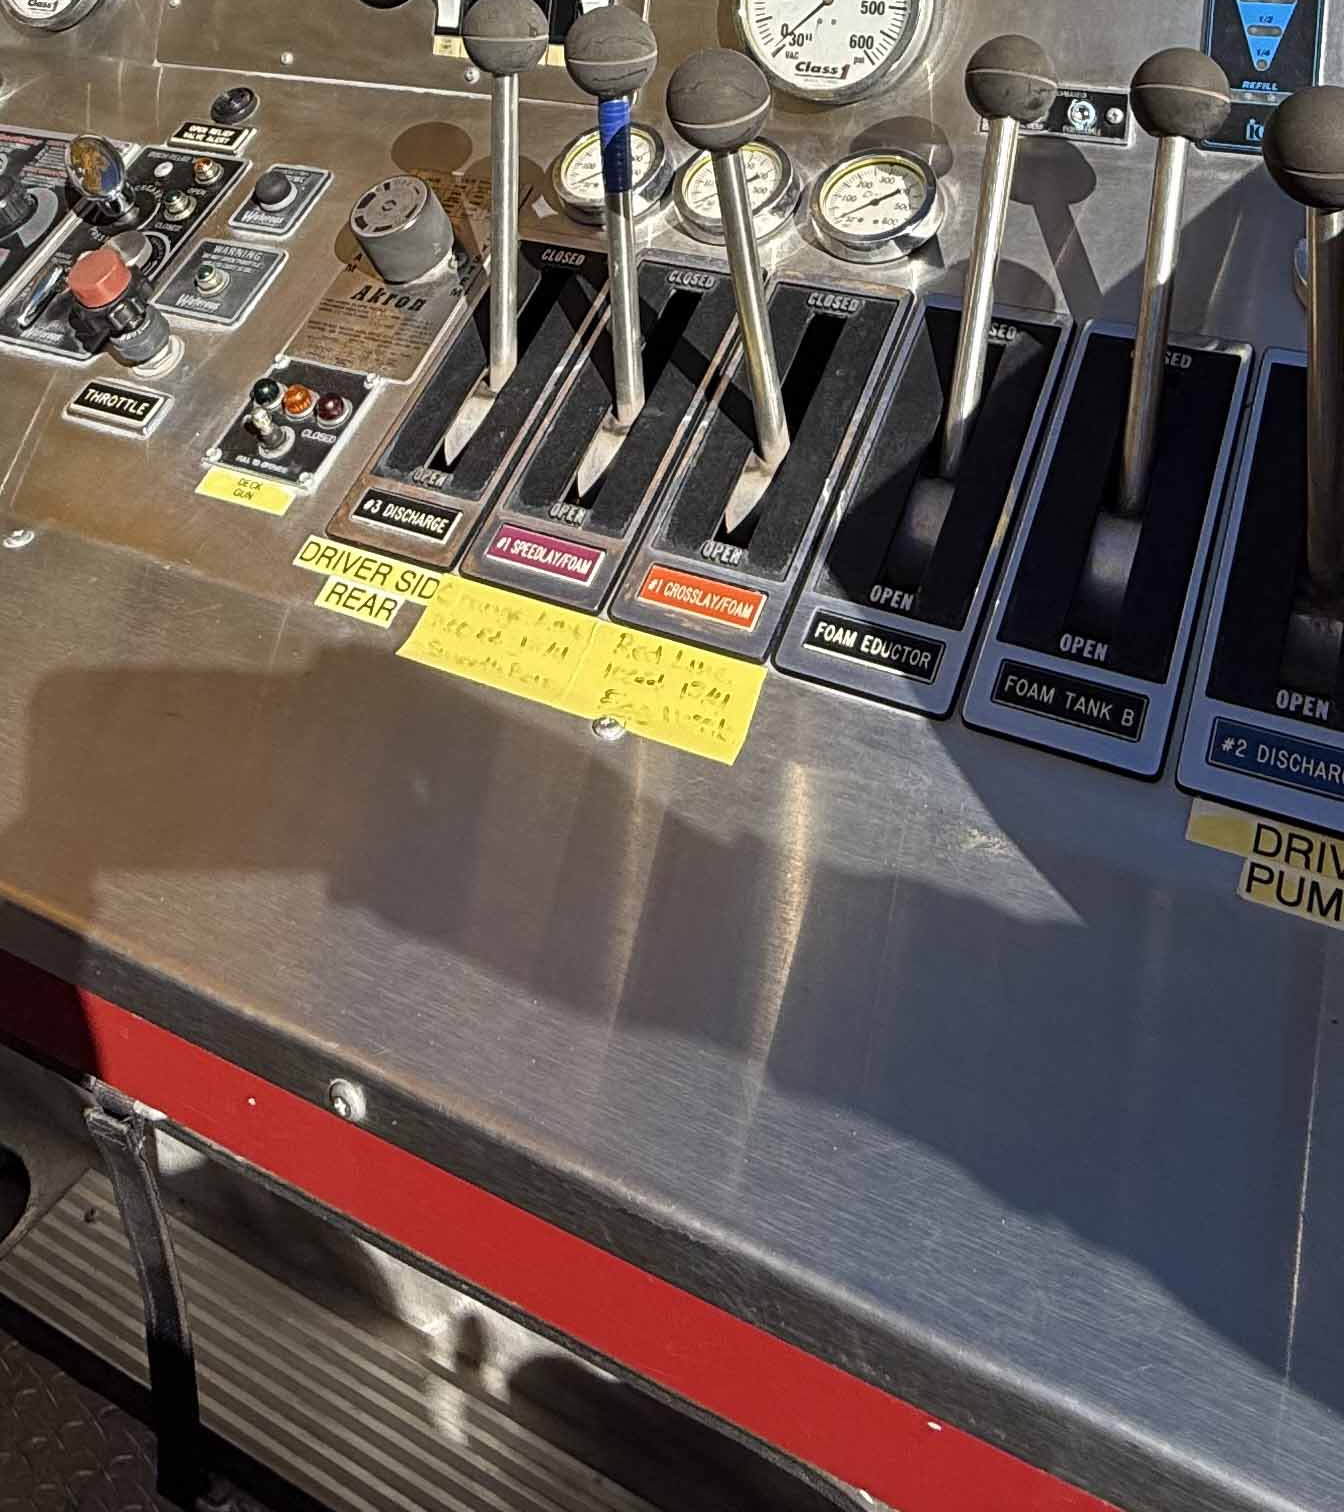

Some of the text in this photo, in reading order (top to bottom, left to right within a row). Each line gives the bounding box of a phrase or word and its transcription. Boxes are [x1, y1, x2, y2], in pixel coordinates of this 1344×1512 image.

[860, 1, 885, 15] 500
[849, 34, 874, 49] 600
[1242, 81, 1279, 90] REFILL
[541, 249, 586, 266] CLOSED
[668, 269, 715, 289] CLOSED
[351, 285, 427, 312] Akron
[807, 292, 859, 312] CLOSED
[84, 388, 150, 415] THROTTLE
[301, 429, 337, 443] CLOSED
[238, 478, 264, 490] DECK
[412, 467, 449, 487] OPEN
[233, 488, 254, 501] GUN
[363, 498, 450, 534] #3 DISCHARGE
[549, 503, 586, 525] OPEN
[496, 537, 592, 575] #1 SPEEDLAY/FOAM
[702, 540, 743, 564] OPEN
[299, 541, 440, 599] DRIVER SID
[324, 581, 398, 622] REAR
[648, 578, 754, 619] #1 CROSSLAY/FOAM
[869, 585, 914, 611] OPEN
[814, 621, 932, 670] FOAM EDUCTOR
[1059, 633, 1108, 662] OPEN
[1004, 674, 1135, 727] FOAM TANK B
[1276, 689, 1329, 721] OPEN
[1221, 737, 1248, 758] #2
